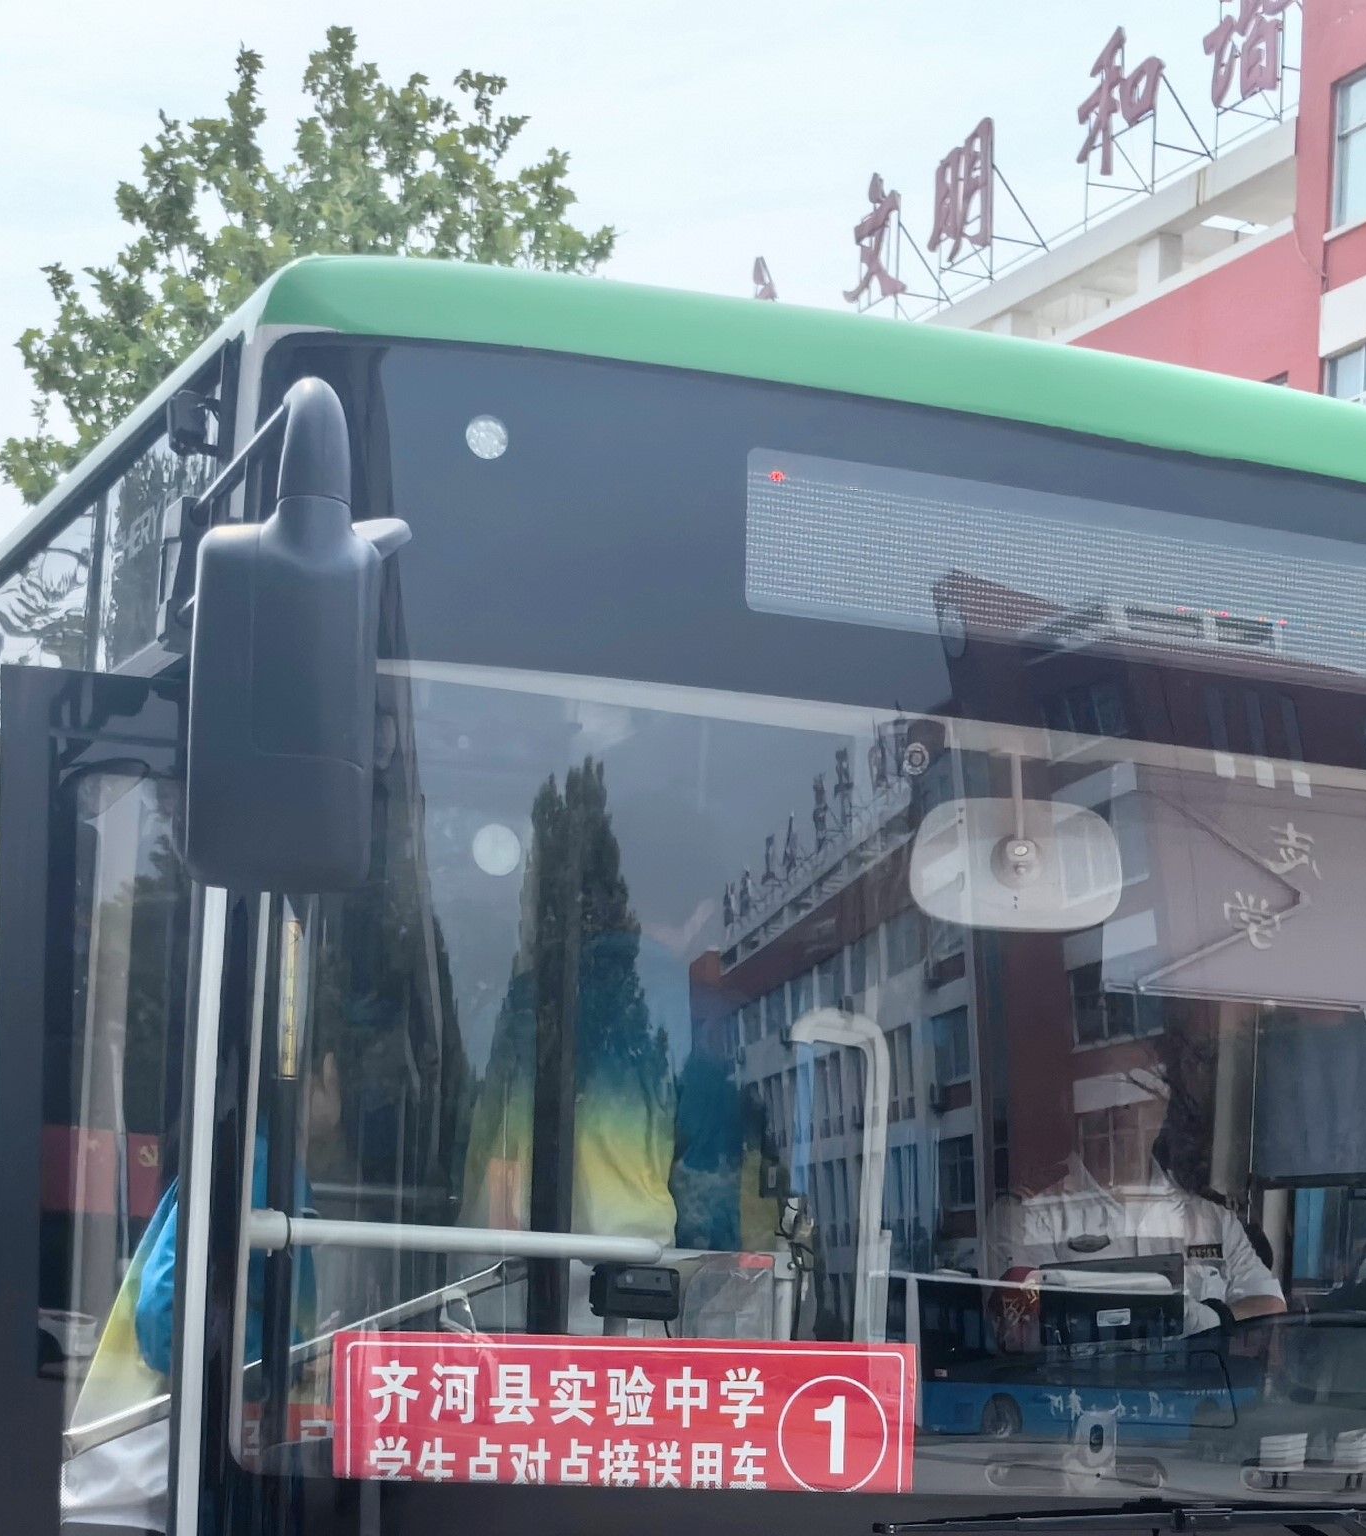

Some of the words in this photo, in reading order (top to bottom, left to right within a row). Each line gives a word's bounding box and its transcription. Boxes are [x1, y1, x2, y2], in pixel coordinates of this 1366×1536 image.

[368, 1359, 765, 1429] 齐河县实验中学
[368, 1436, 767, 1490] 学生点对点接送用车
[814, 1395, 846, 1474] 1
